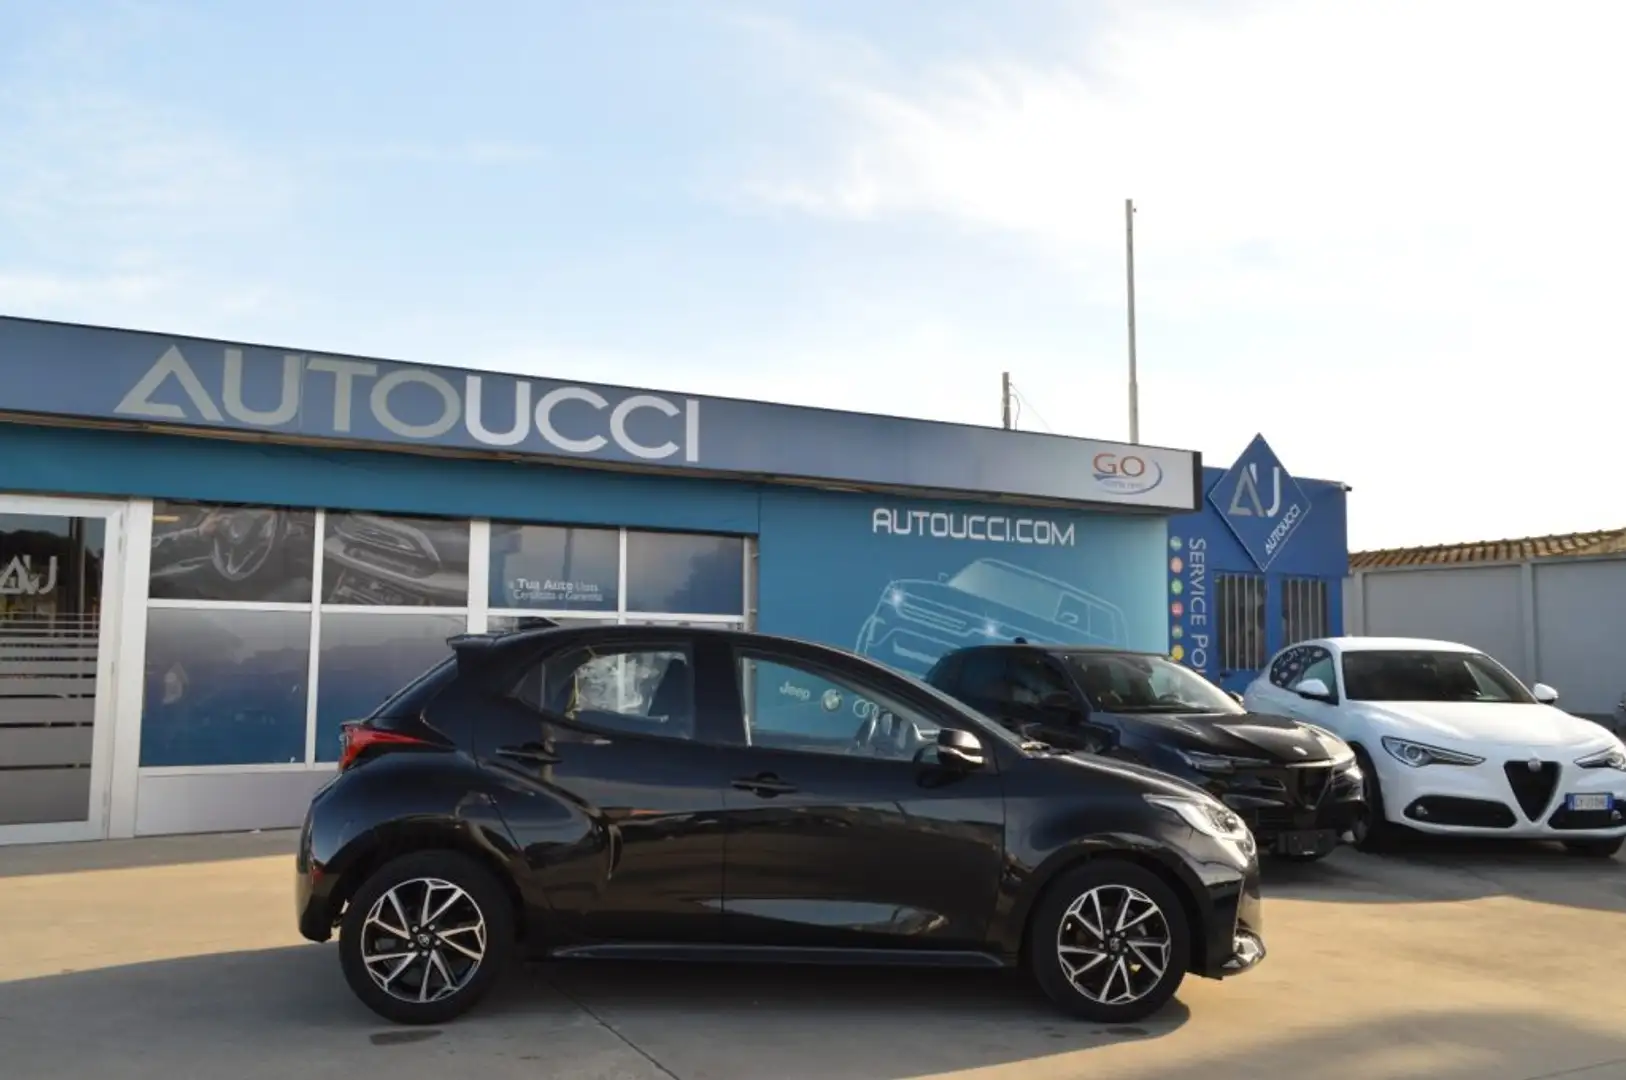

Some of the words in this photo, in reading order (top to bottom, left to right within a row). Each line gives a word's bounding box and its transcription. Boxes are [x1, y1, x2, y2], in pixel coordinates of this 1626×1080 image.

[113, 344, 700, 463] AUTOUCCI
[1093, 452, 1146, 477] GO
[872, 508, 1076, 547] AUTOUCCI.COM
[1265, 503, 1302, 556] AUTOUCCI
[1188, 537, 1207, 626] SERVICE
[779, 681, 811, 701] Jeep
